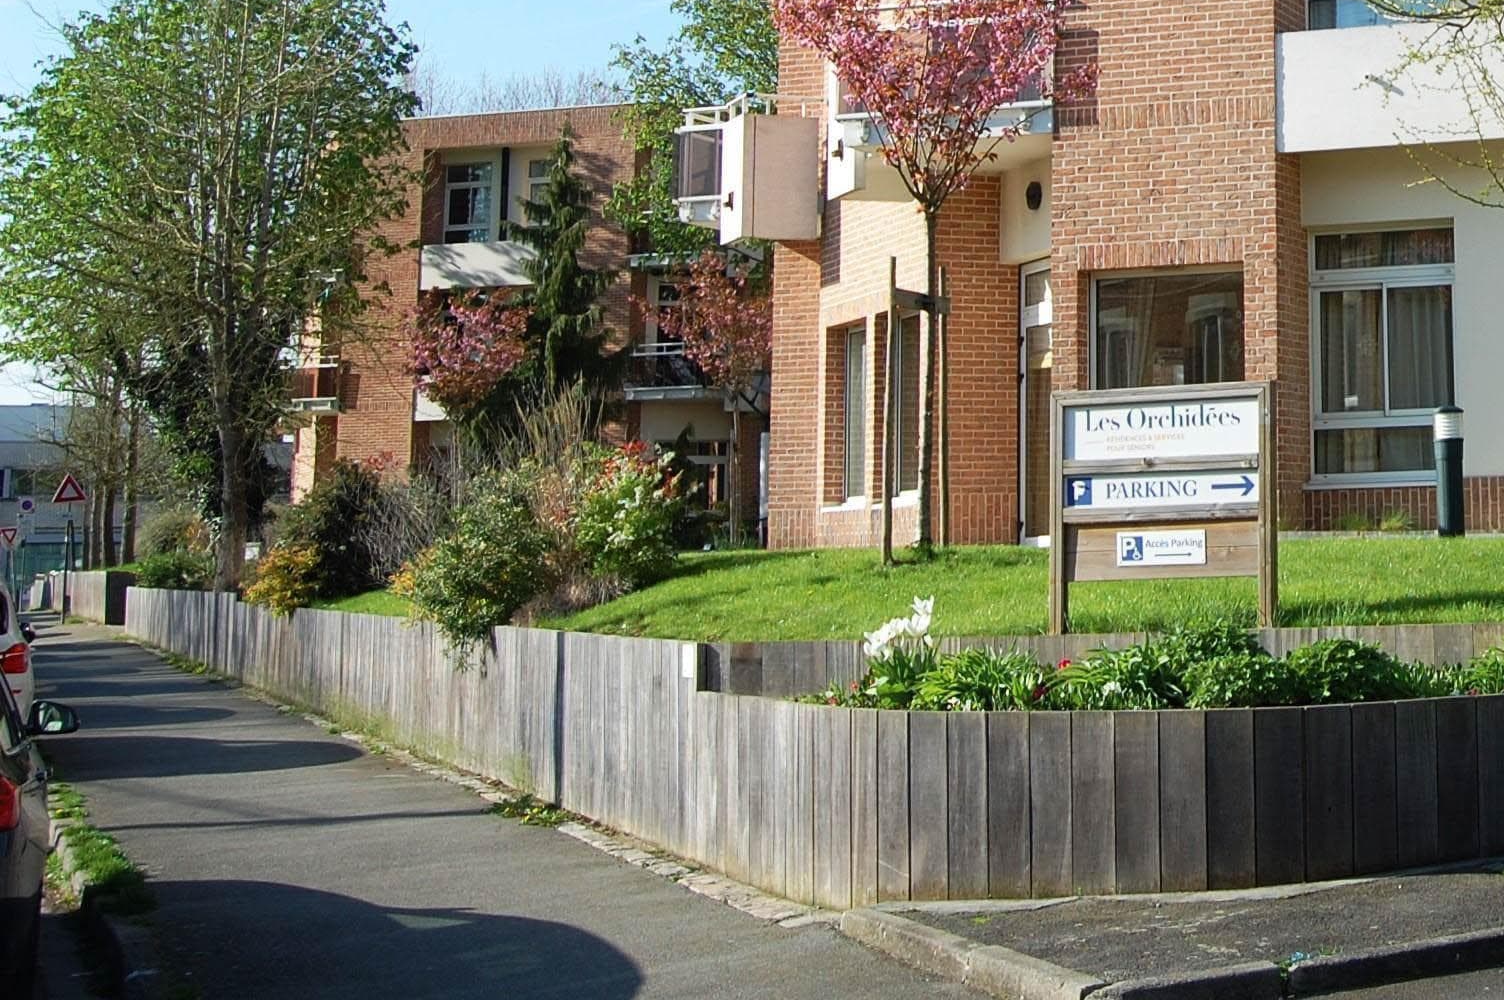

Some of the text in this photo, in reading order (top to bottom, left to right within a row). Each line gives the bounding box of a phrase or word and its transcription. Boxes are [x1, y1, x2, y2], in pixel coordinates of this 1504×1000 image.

[1086, 404, 1241, 432] Les Orchidées
[1106, 480, 1198, 499] PARKING
[1171, 537, 1203, 549] Parking
